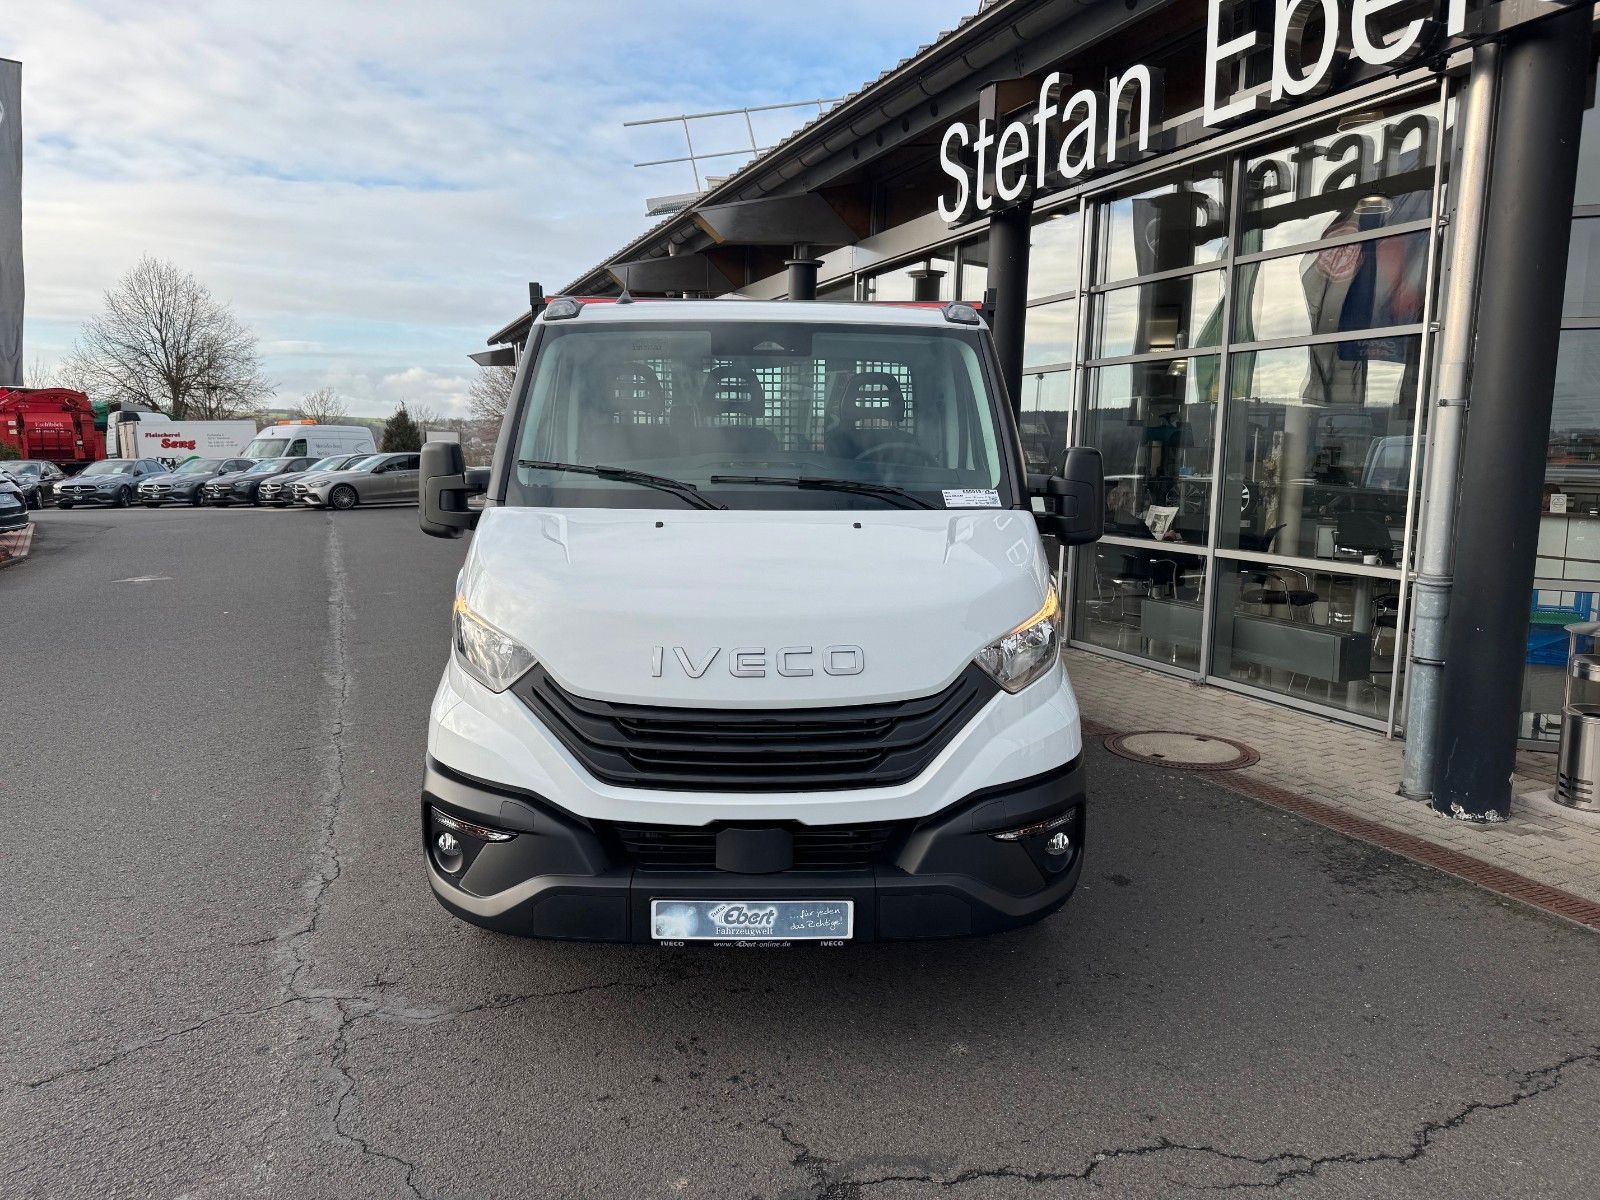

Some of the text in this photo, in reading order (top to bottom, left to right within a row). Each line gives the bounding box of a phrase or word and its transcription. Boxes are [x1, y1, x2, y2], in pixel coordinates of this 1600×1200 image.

[937, 0, 1466, 224] Stefan Ebe
[161, 438, 196, 450] Seng
[651, 645, 865, 679] IVECO
[723, 906, 775, 925] Ebert
[716, 927, 773, 936] Fahrzeugwelt
[790, 923, 805, 931] das
